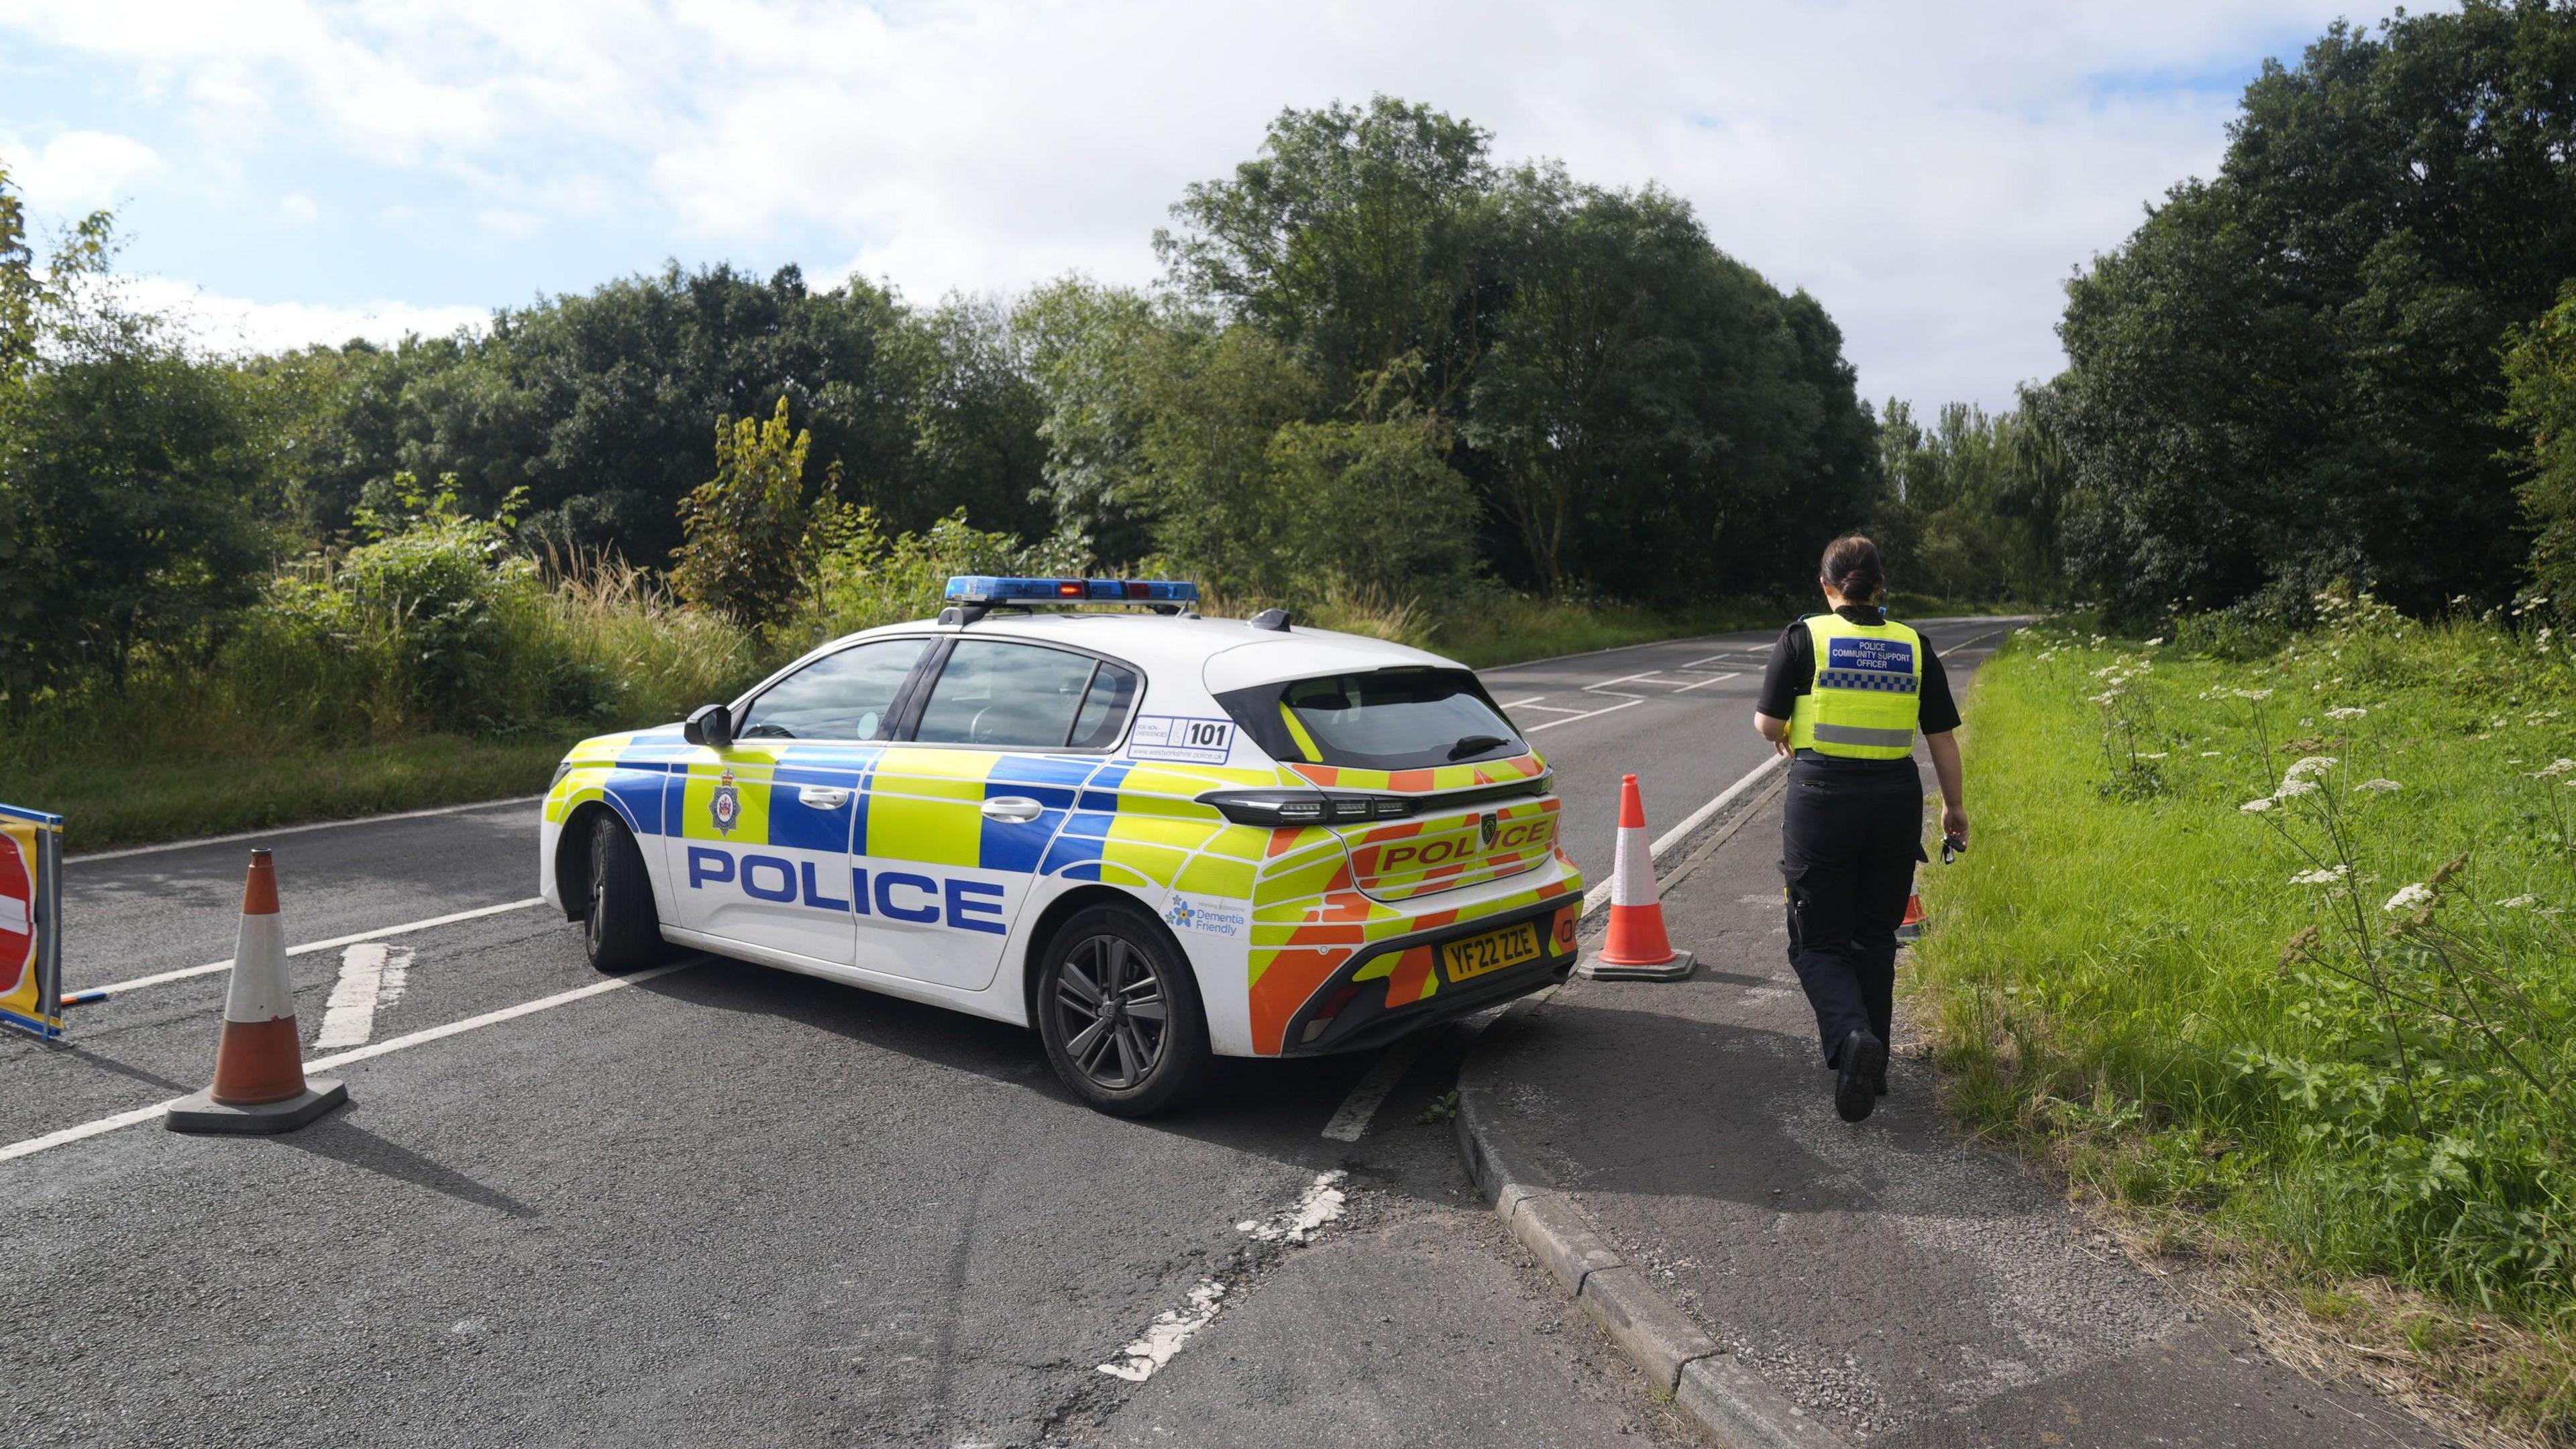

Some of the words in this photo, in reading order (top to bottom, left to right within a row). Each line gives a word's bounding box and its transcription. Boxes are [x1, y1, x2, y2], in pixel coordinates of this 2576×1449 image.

[1859, 641, 1886, 651] POLICE
[1832, 649, 1876, 659] COMMUNITY
[1878, 652, 1911, 662] SUPPORT
[1856, 659, 1887, 668] OFFICER
[1191, 723, 1226, 746] 101
[1382, 819, 1548, 871] POLICE
[688, 846, 1006, 935] POLICE
[1197, 909, 1244, 924] Dementia
[1196, 920, 1237, 936] Friendly
[1450, 937, 1500, 974] YF22
[1499, 928, 1533, 961] ZZE
